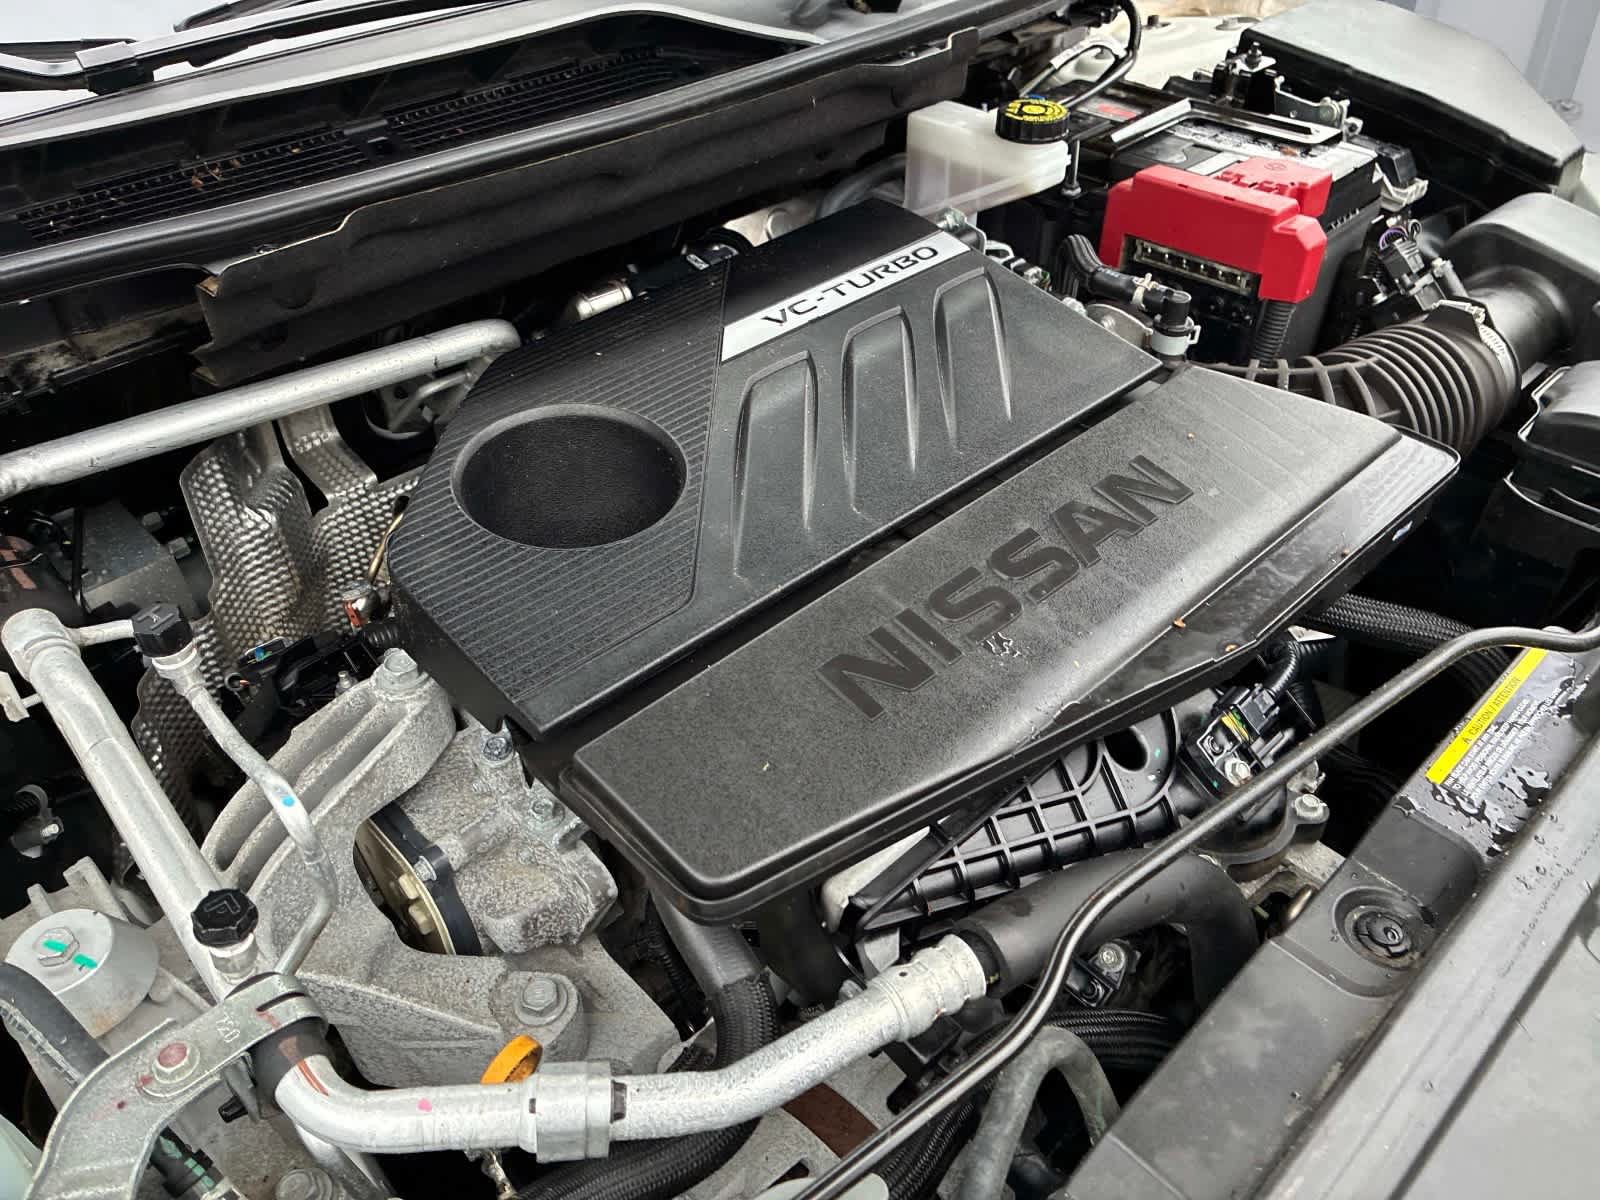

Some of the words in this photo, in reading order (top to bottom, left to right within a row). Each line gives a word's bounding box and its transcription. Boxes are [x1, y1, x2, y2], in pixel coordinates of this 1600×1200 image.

[761, 246, 939, 326] VC-TURBO
[815, 454, 1195, 721] NISSAN
[1470, 710, 1492, 735] CAUTION
